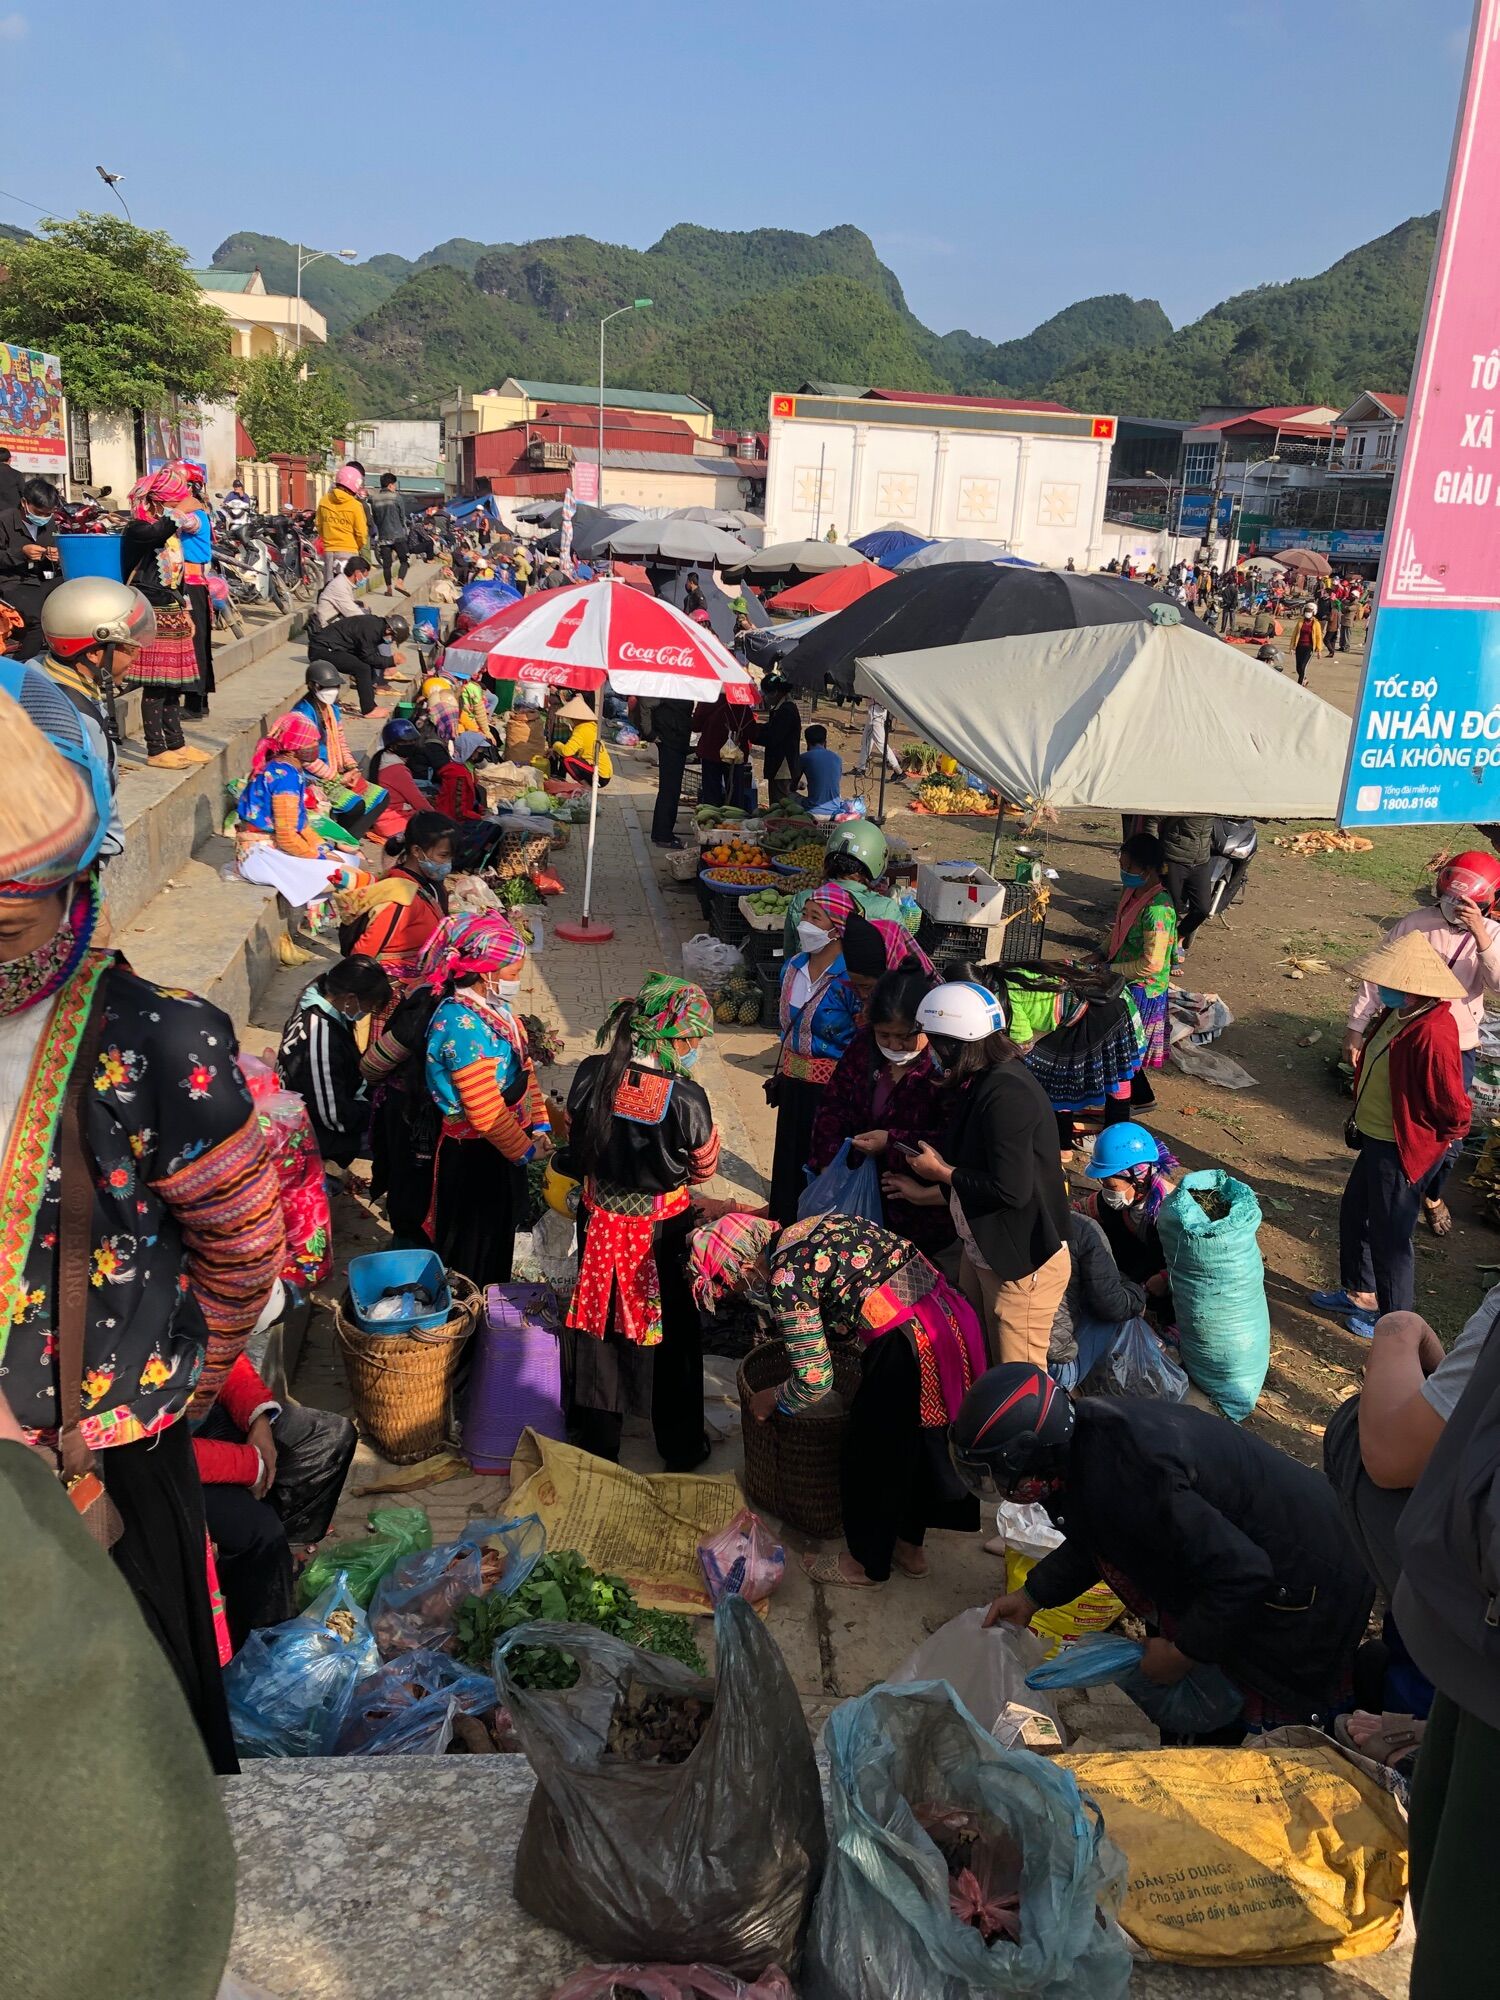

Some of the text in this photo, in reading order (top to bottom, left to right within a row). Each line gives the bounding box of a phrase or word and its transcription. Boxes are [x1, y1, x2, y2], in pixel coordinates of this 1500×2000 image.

[1460, 409, 1495, 449] XÃ
[1434, 465, 1492, 506] GIÀU
[619, 642, 694, 668] Coca-Cola
[519, 663, 571, 684] Coca-Cola
[1374, 673, 1438, 702] TỐC ĐỘ
[1366, 703, 1456, 740] NHÂN
[1361, 744, 1396, 768] GIÁ
[1400, 743, 1472, 768] KHÔNG
[1383, 797, 1438, 809] 1800.8168
